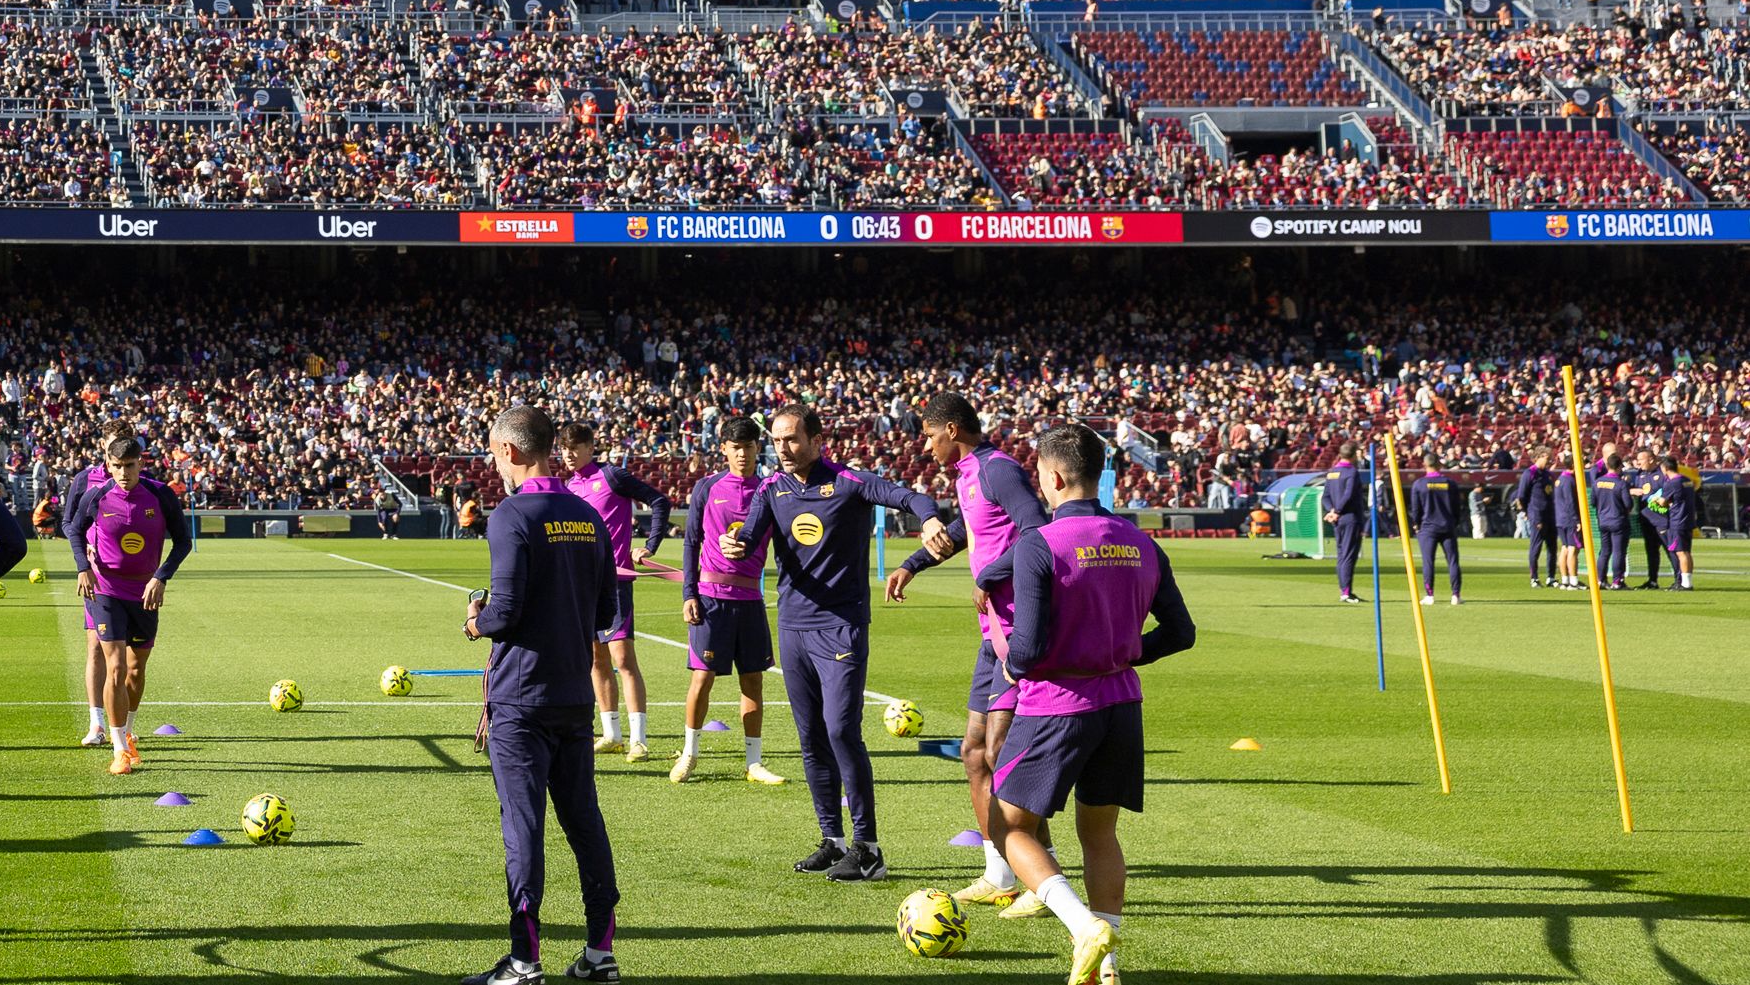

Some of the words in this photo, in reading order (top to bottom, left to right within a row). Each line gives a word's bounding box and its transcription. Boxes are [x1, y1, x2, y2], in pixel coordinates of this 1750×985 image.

[99, 214, 158, 237] Uber
[318, 215, 377, 238] Uber
[496, 219, 559, 232] ESTRELLA
[656, 215, 679, 239] FC
[682, 215, 786, 239] BARCELONA
[820, 214, 838, 240] 0
[851, 215, 901, 239] 06:43
[914, 214, 933, 240] 0
[961, 215, 984, 239] FC
[987, 215, 1092, 239] BARCELONA
[1273, 219, 1338, 235] SPOTIFY
[1340, 219, 1386, 235] CAMP
[1388, 219, 1422, 234] NOU
[1577, 213, 1601, 237] FC
[1604, 213, 1714, 237] BARCELONA
[544, 521, 563, 535] R.D.
[563, 521, 595, 535] CONGO
[1074, 546, 1099, 560] R.D.
[1099, 544, 1141, 559] CONGO
